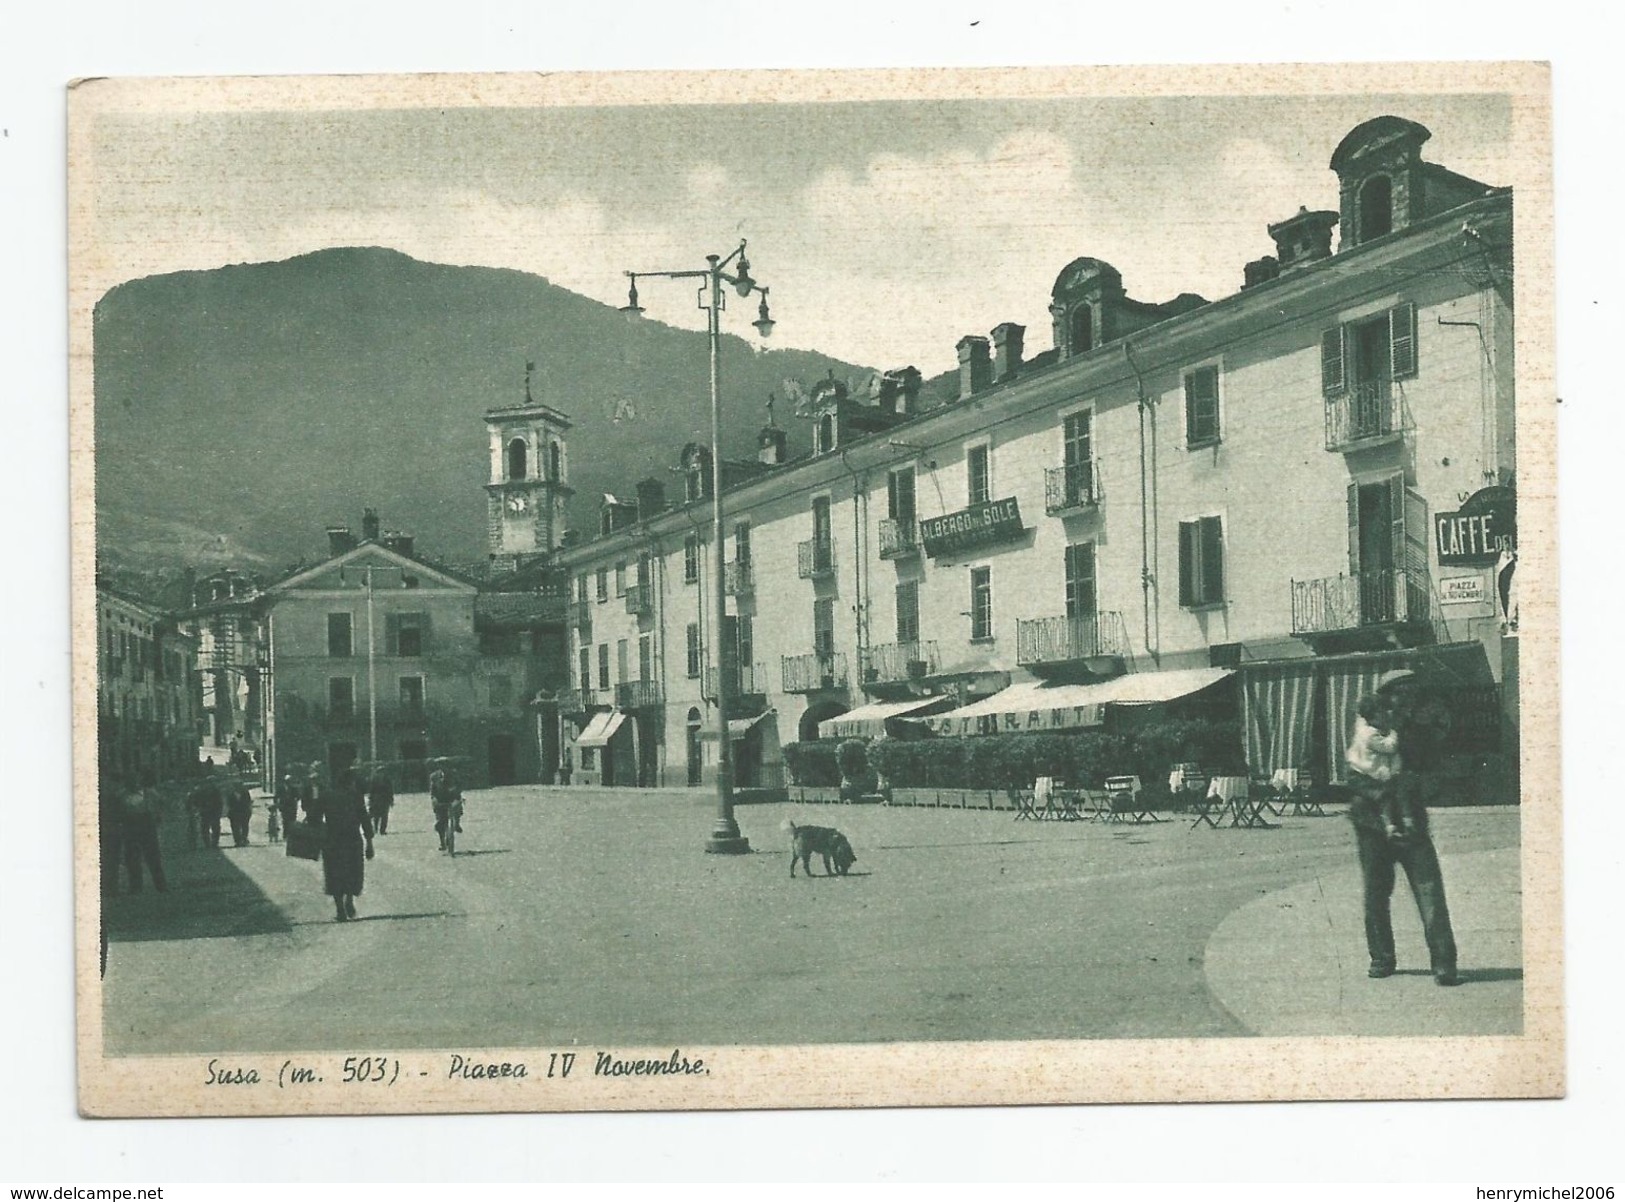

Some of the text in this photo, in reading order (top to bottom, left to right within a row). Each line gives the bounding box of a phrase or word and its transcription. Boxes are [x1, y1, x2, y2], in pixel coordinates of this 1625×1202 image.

[922, 513, 972, 539] ALBERGO
[983, 502, 1017, 526] SOLE
[1449, 580, 1477, 591] PIAZZA
